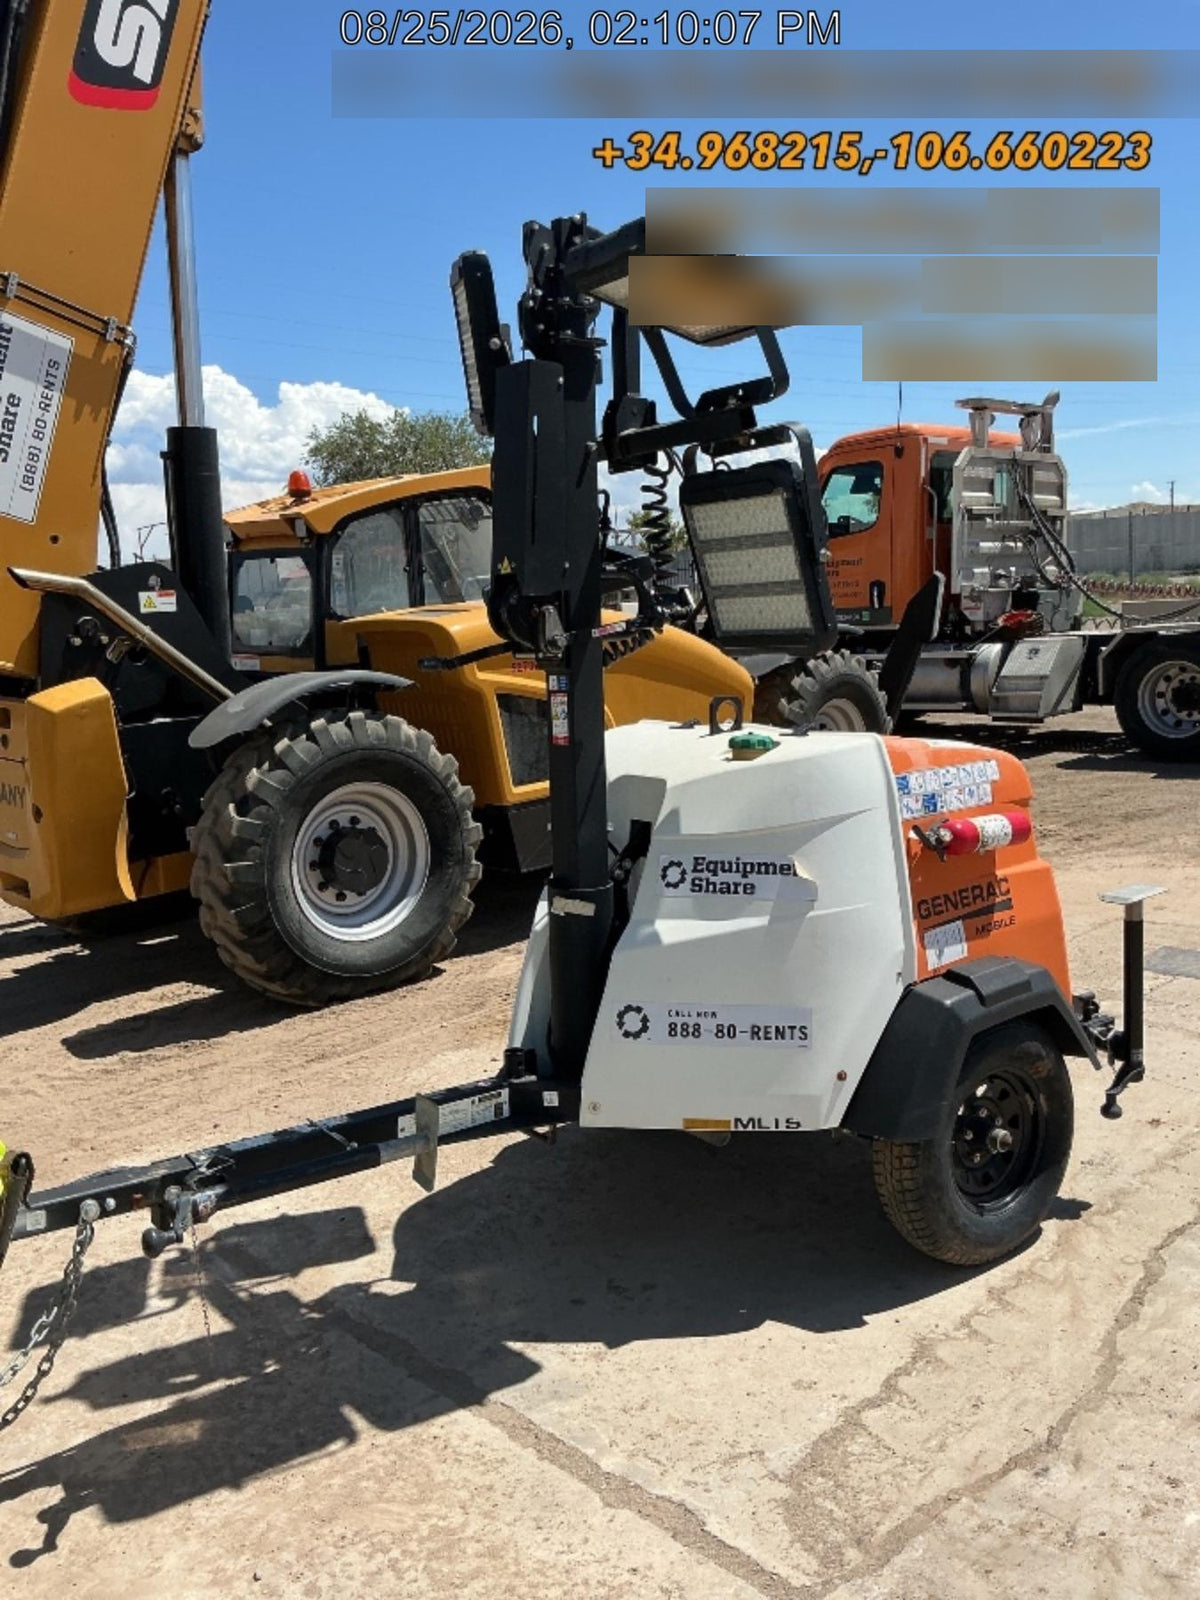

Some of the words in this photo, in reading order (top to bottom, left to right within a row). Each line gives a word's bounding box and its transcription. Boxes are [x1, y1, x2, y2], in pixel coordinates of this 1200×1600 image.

[32, 358, 61, 442] 80-RENTS
[690, 876, 756, 896] Share
[917, 876, 1011, 919] GENERAC
[975, 915, 1017, 936] MOBILE
